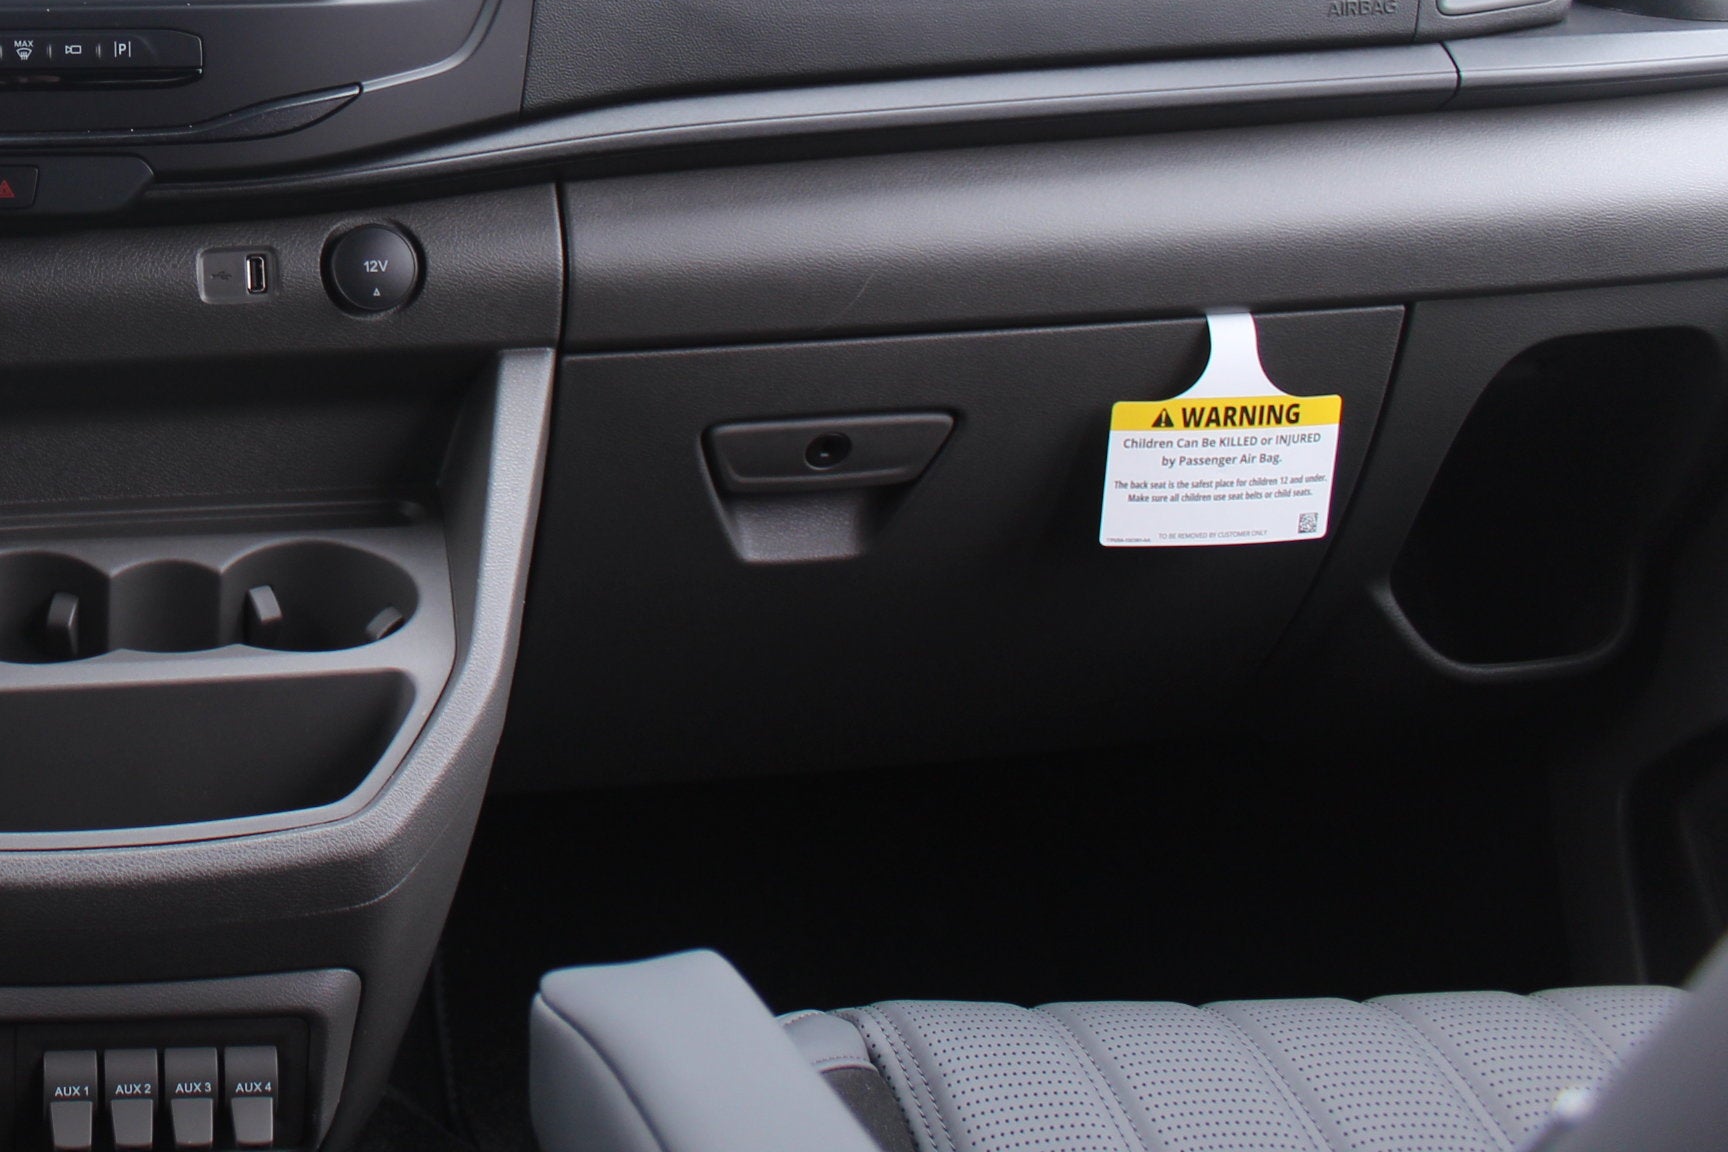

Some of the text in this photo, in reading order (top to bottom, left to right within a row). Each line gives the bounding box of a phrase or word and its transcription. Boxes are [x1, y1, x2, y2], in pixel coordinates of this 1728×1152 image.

[14, 40, 34, 48] MAX
[363, 260, 388, 274] 12V
[1181, 403, 1301, 428] WARNING
[1122, 433, 1322, 449] Children Can Be KILLED or INJURED
[1161, 453, 1283, 468] by Passenger Air Bag.
[1114, 474, 1328, 490] The back seat is the safest place for children 12 and under.
[1127, 494, 1150, 502] Make
[1151, 495, 1168, 503] sure
[1169, 493, 1180, 502] all
[1181, 493, 1212, 502] children
[1227, 492, 1244, 501] seat
[1244, 491, 1263, 500] belts
[1264, 491, 1273, 499] or
[1273, 489, 1292, 498] child
[1292, 488, 1313, 497] seats.
[1218, 530, 1250, 538] CUSTOMER
[54, 1085, 90, 1097] AUX 1
[115, 1083, 152, 1095] AUX 2
[174, 1082, 212, 1094] AUX 3
[235, 1081, 272, 1093] AUX 4
